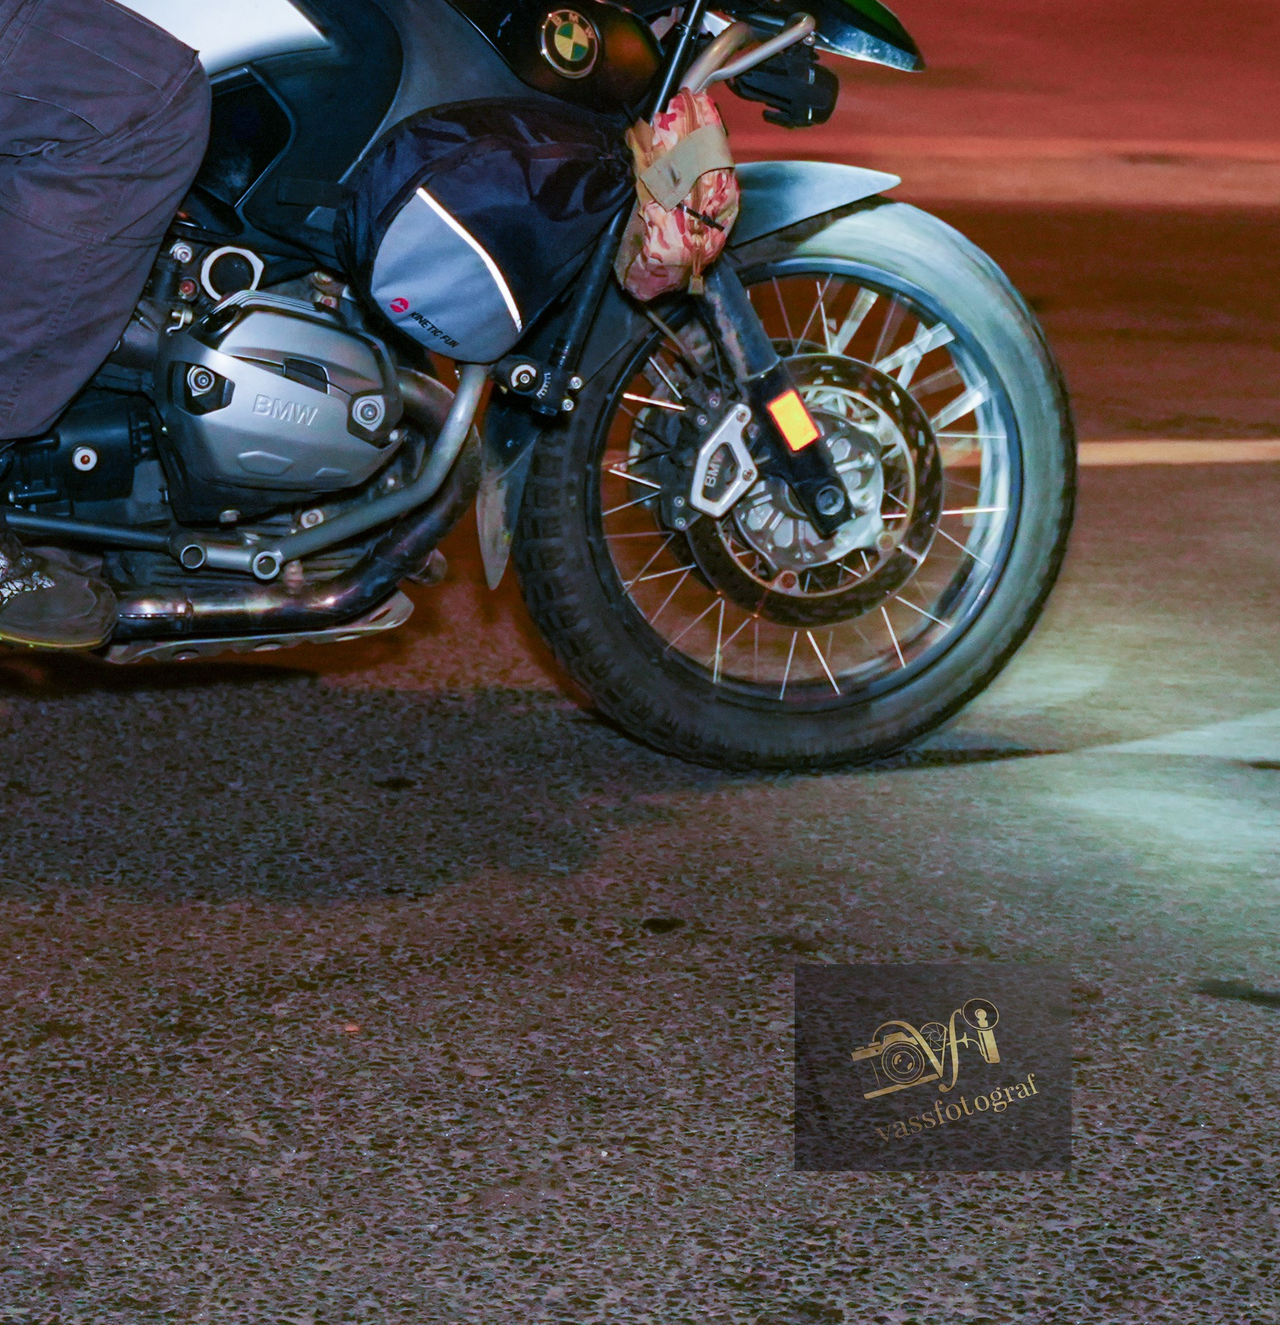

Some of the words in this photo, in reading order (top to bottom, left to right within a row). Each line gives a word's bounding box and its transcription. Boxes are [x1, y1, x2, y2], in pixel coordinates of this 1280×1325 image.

[551, 12, 596, 40] BMW
[410, 311, 443, 337] KINETIC
[439, 335, 460, 348] FUN
[252, 393, 318, 426] BMW
